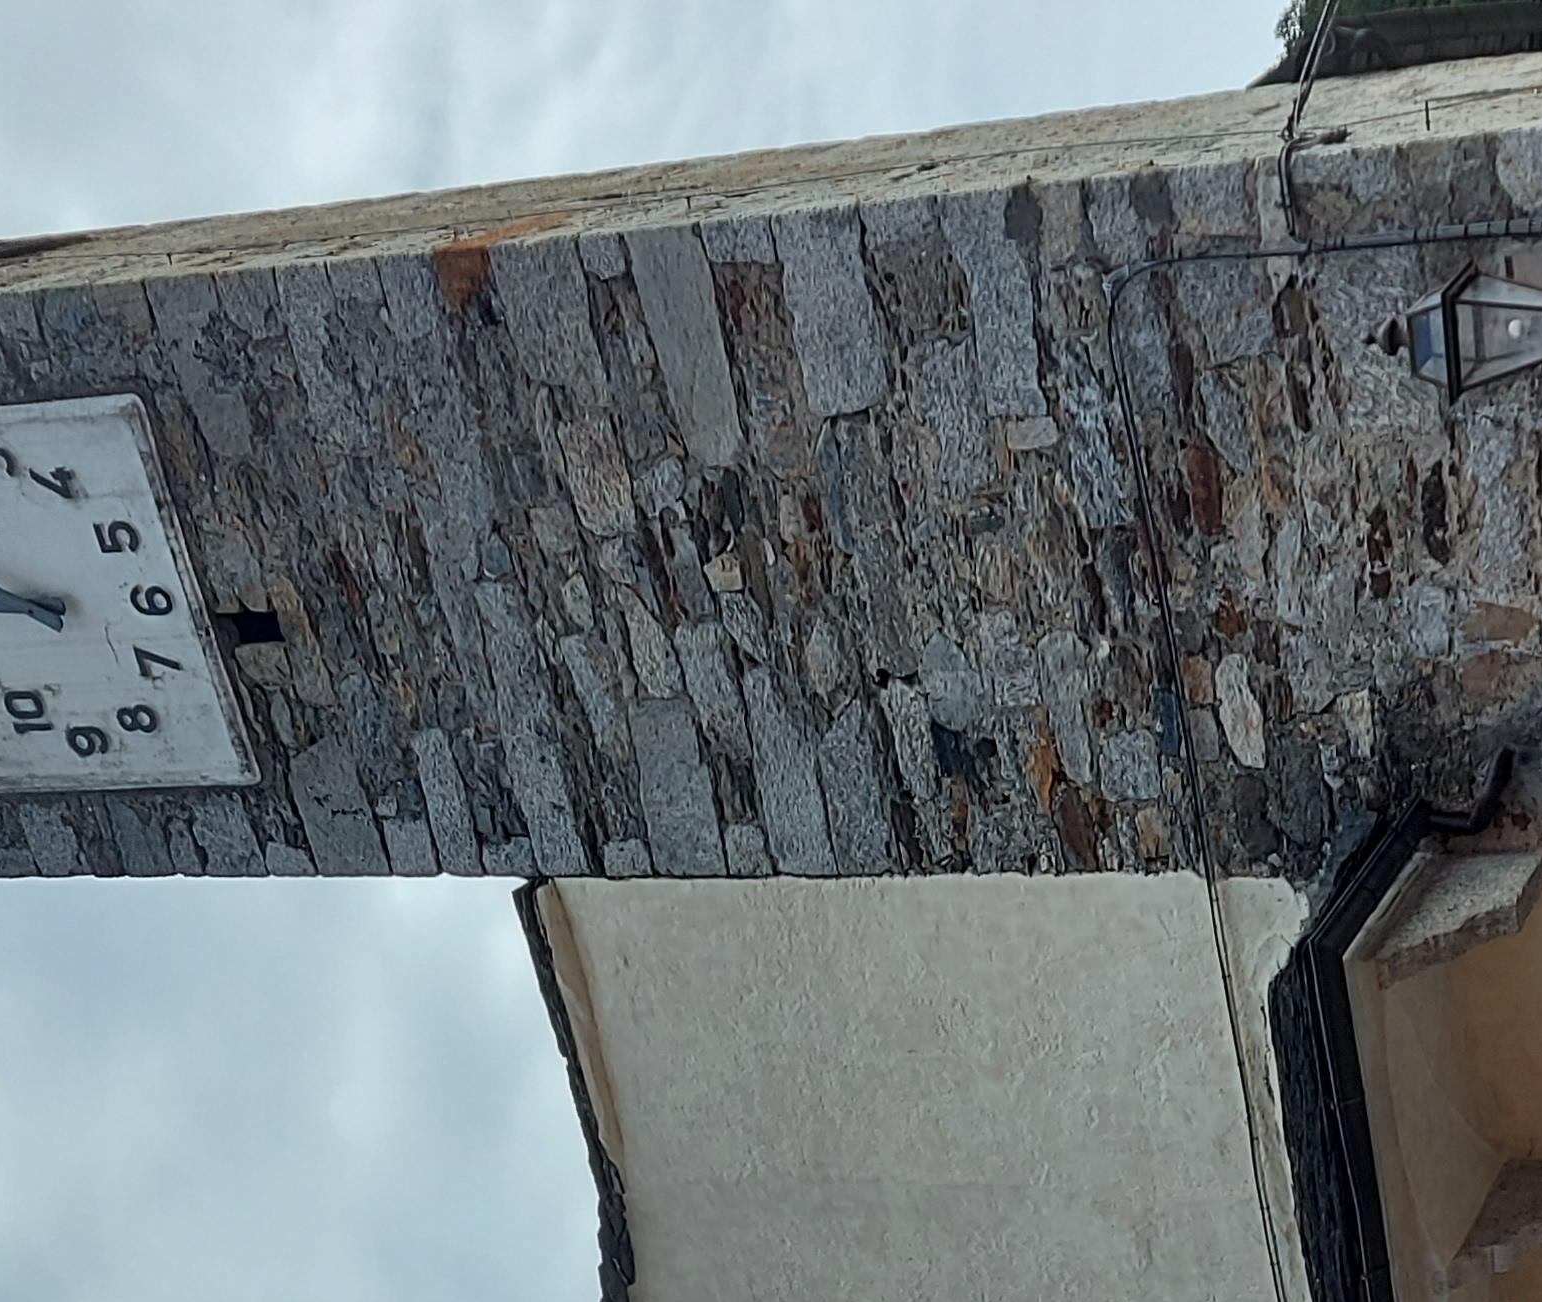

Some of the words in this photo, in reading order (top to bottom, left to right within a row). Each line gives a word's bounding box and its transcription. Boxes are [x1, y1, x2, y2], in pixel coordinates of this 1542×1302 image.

[28, 466, 76, 500] 4
[93, 520, 139, 553] 5
[130, 584, 173, 616] 6
[132, 645, 183, 677] 7
[3, 690, 53, 734] 10
[116, 704, 158, 733] 8
[65, 724, 109, 757] 9
